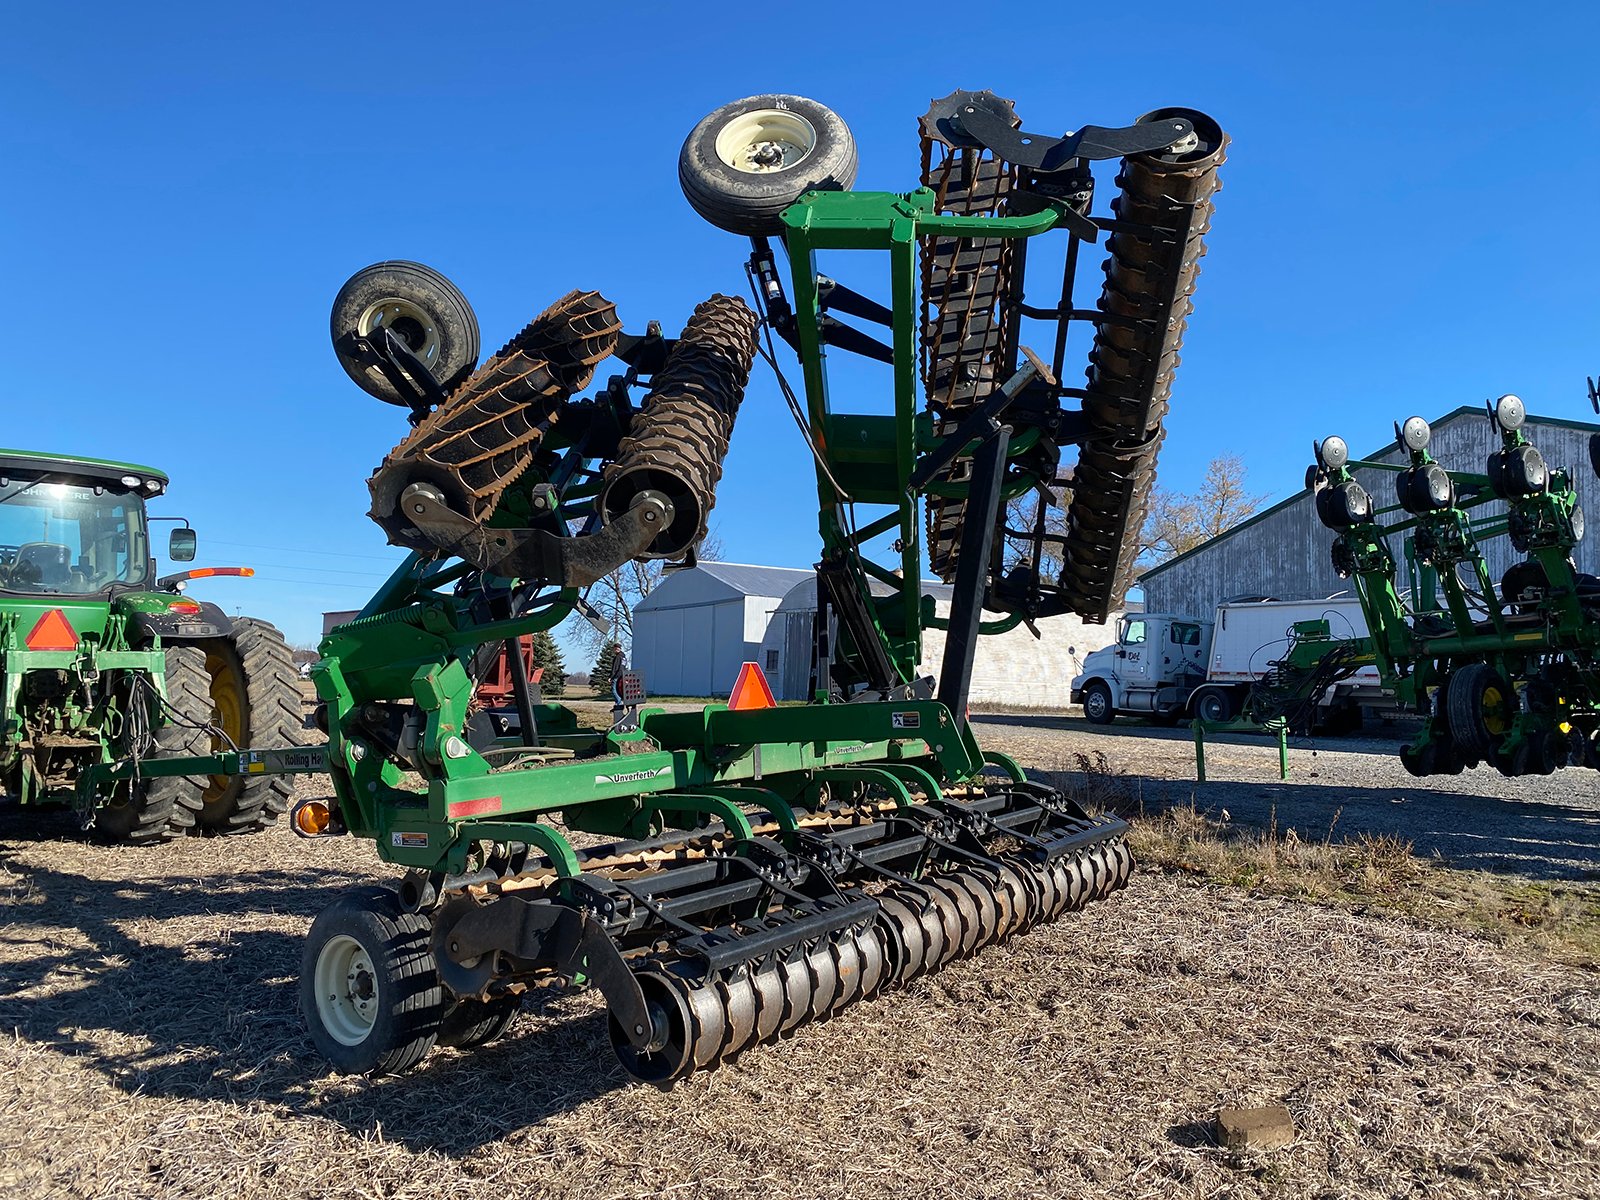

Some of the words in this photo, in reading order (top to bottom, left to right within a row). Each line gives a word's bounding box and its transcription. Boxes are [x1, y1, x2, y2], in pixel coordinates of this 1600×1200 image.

[18, 486, 47, 497] OHN
[284, 753, 309, 768] Rolling
[613, 769, 655, 783] Unverferth
